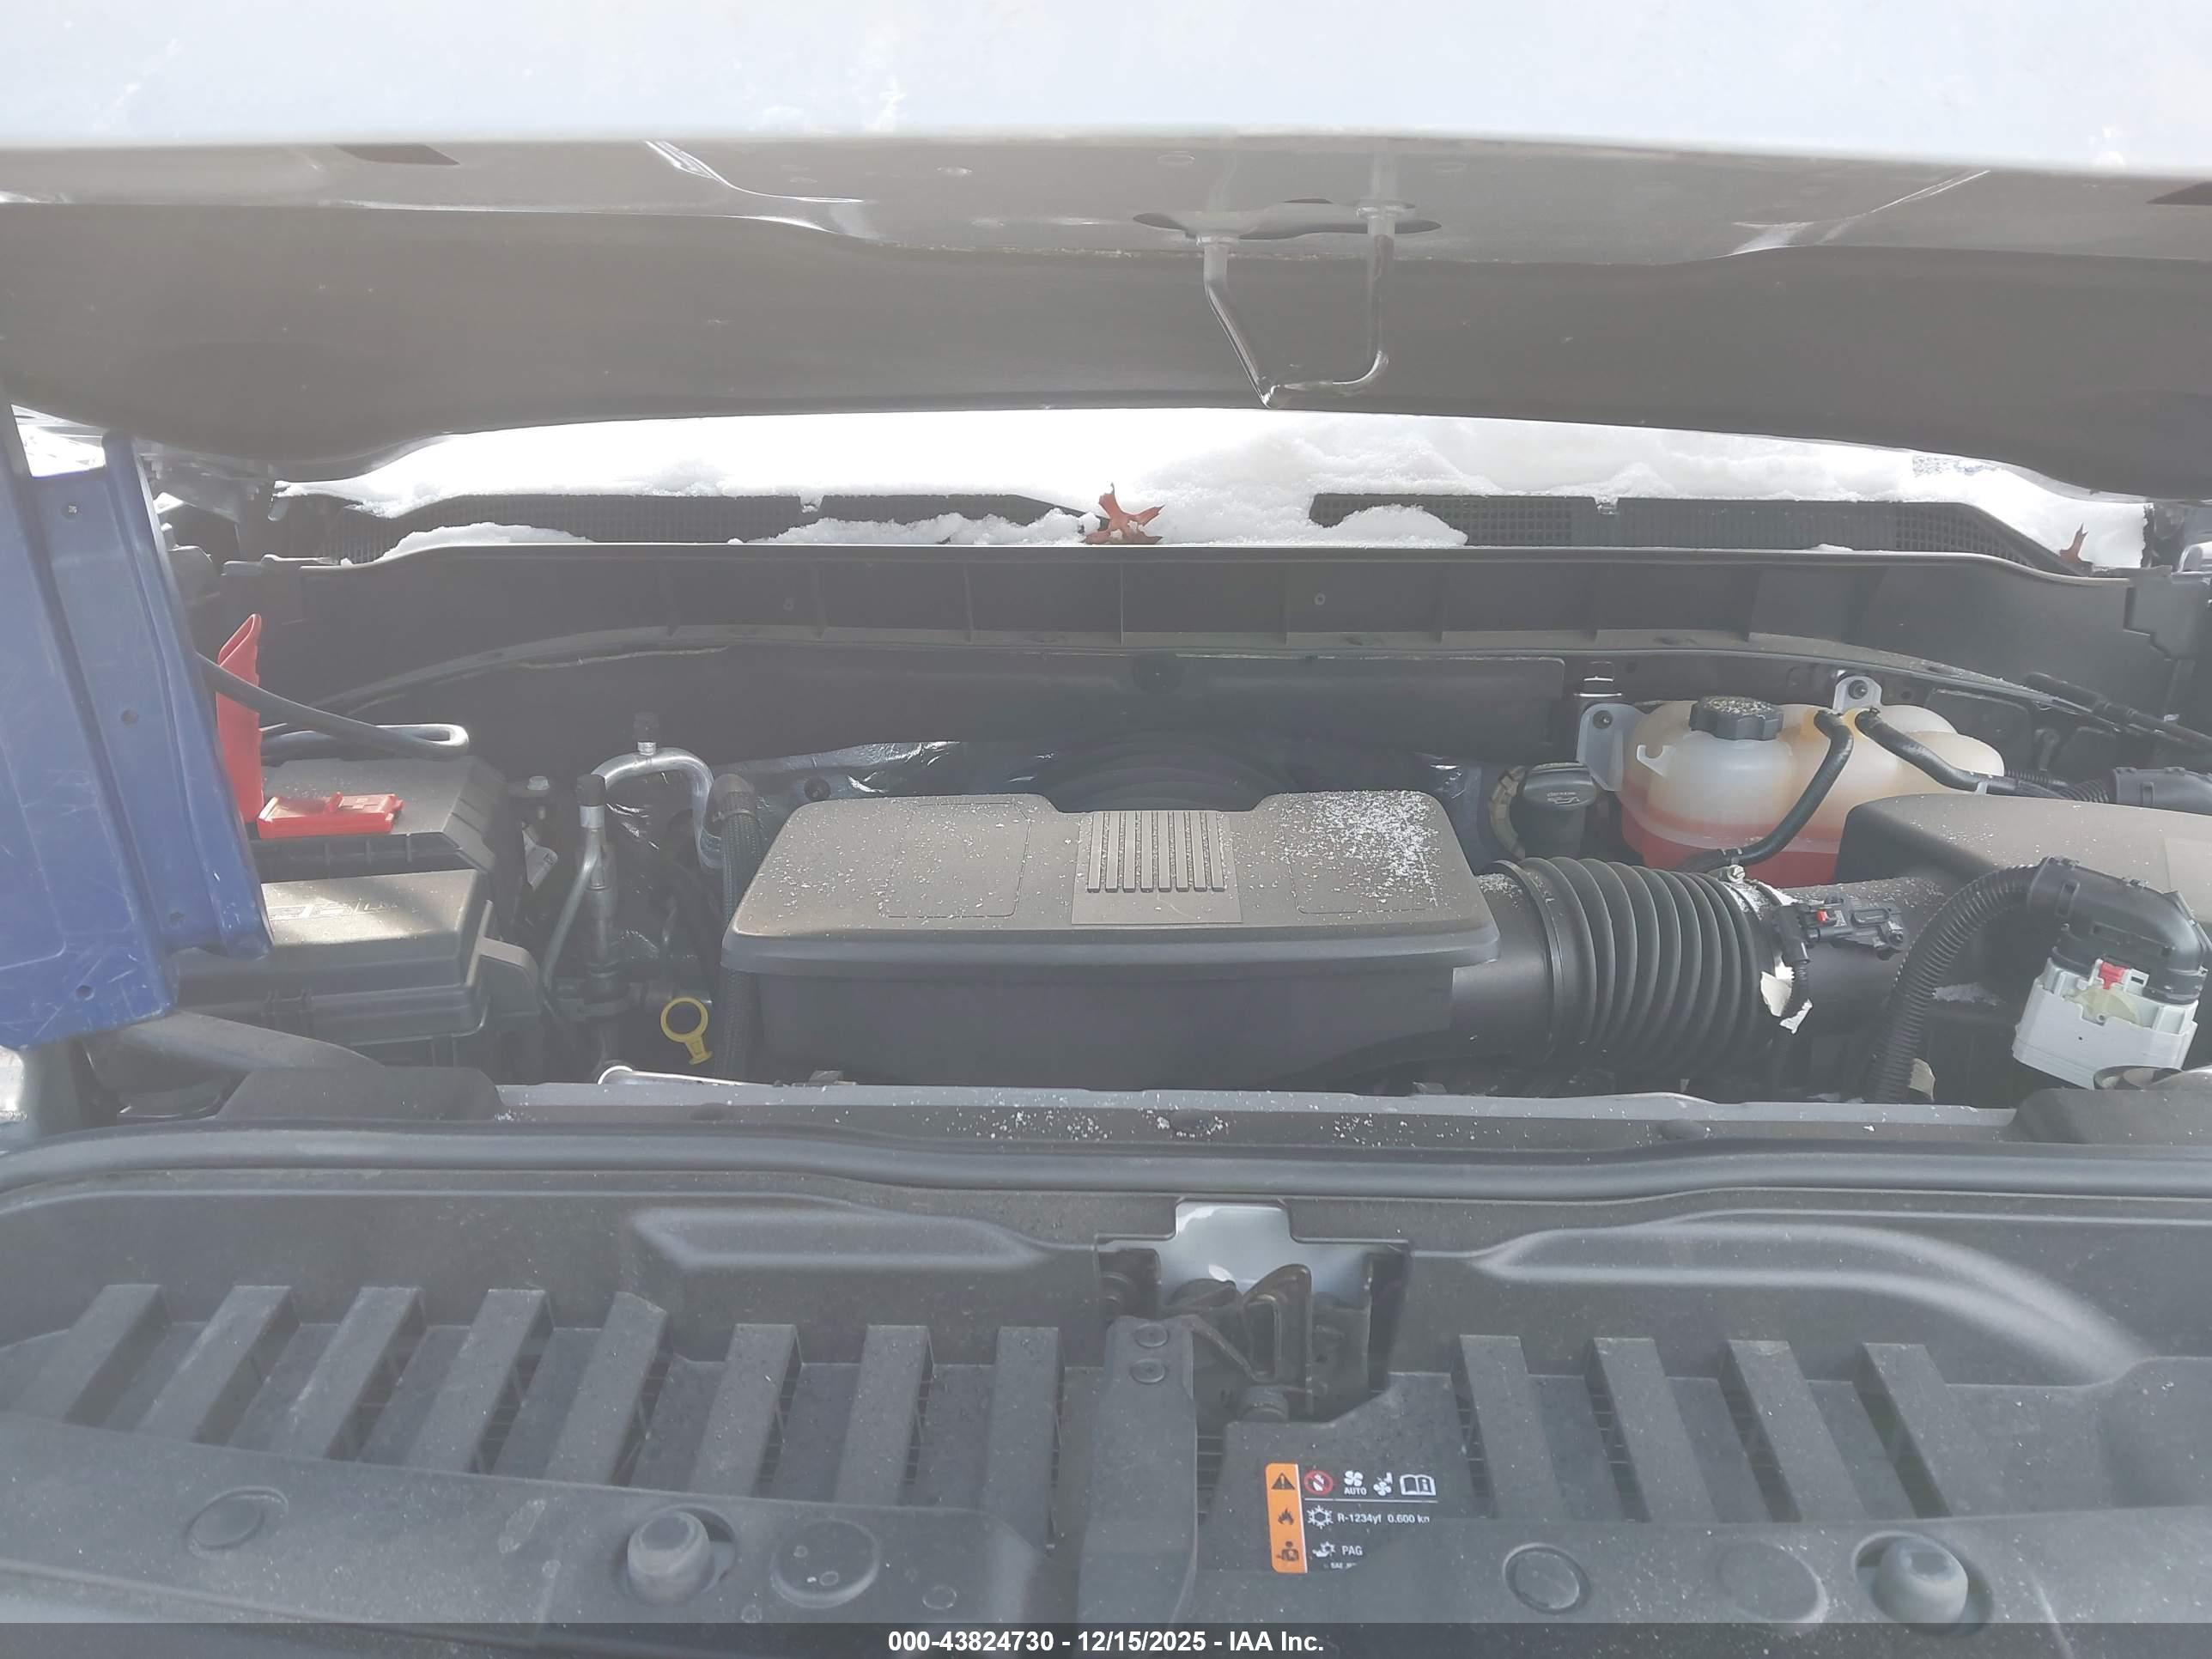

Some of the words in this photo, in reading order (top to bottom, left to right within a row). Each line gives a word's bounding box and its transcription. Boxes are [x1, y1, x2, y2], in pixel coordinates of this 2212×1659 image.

[1344, 1487, 1367, 1496] AUTO
[1337, 1513, 1382, 1525] R-1234yf
[1387, 1513, 1415, 1523] 0.600
[1341, 1545, 1364, 1556] PAG
